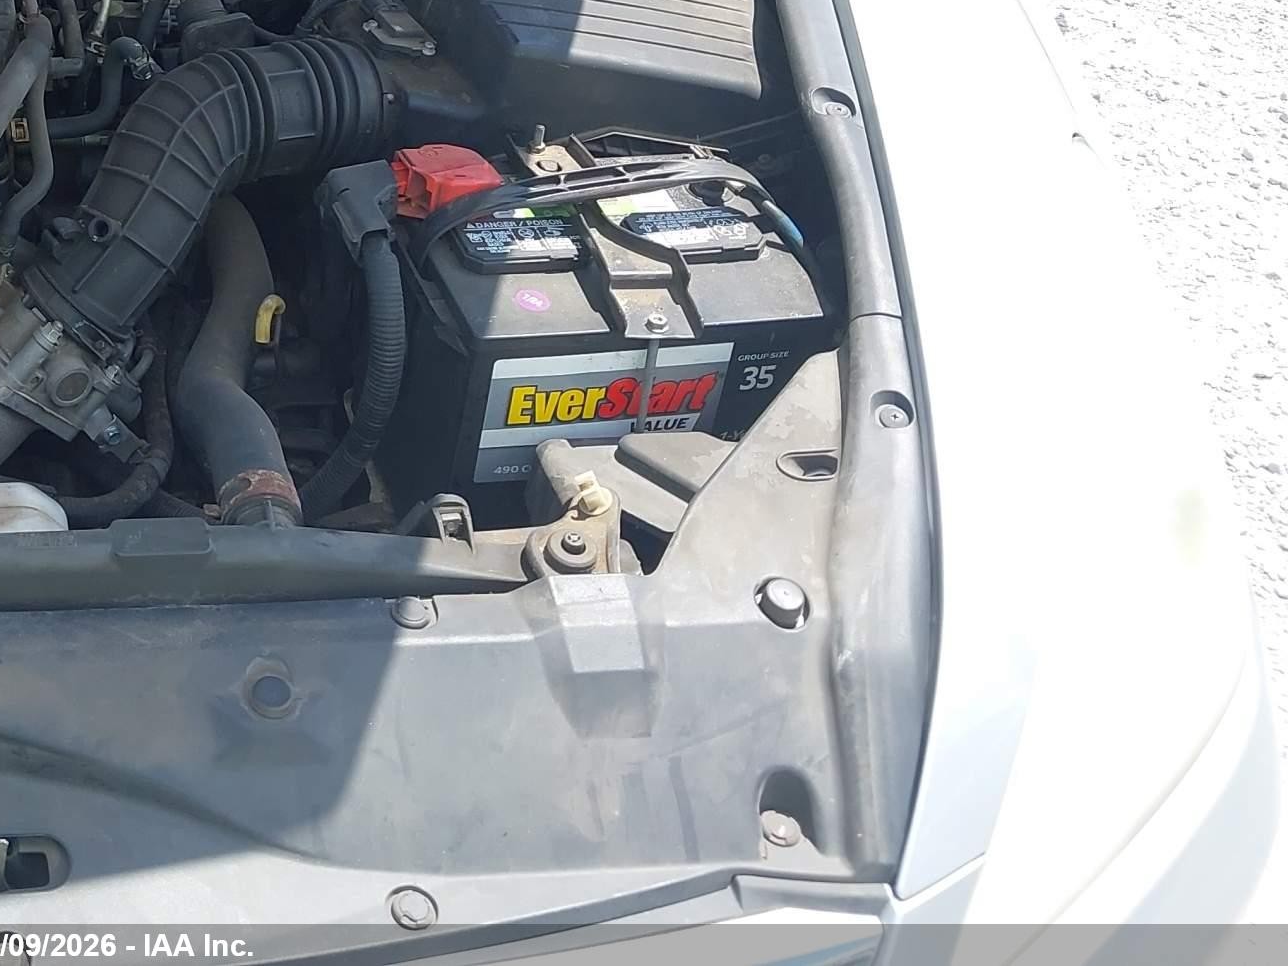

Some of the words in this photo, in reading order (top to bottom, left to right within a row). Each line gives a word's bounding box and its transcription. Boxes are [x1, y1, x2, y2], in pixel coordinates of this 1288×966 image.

[475, 221, 517, 229] DANGER
[737, 353, 769, 362] GROUP
[770, 350, 790, 359] SIZE
[739, 364, 777, 391] 35
[493, 465, 519, 474] 490
